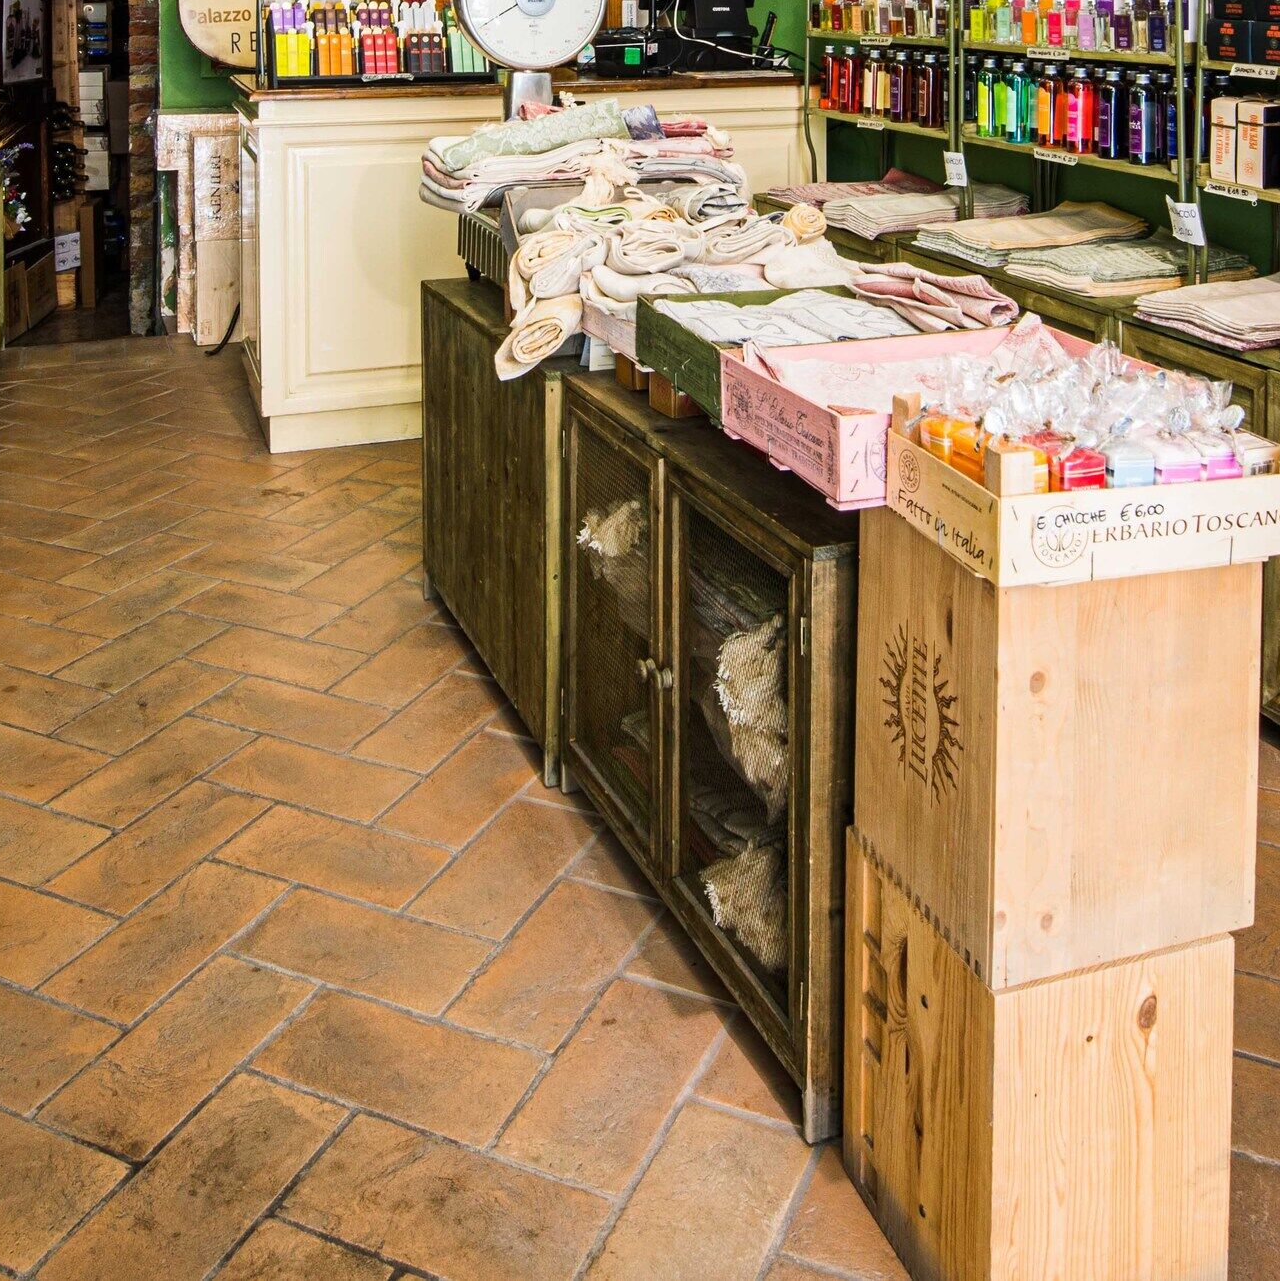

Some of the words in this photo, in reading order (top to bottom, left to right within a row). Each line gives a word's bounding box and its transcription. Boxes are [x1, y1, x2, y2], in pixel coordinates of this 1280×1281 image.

[897, 489, 932, 526] Fatto
[936, 517, 949, 536] in
[950, 526, 985, 564] Italia
[1092, 519, 1188, 543] ERBARIO
